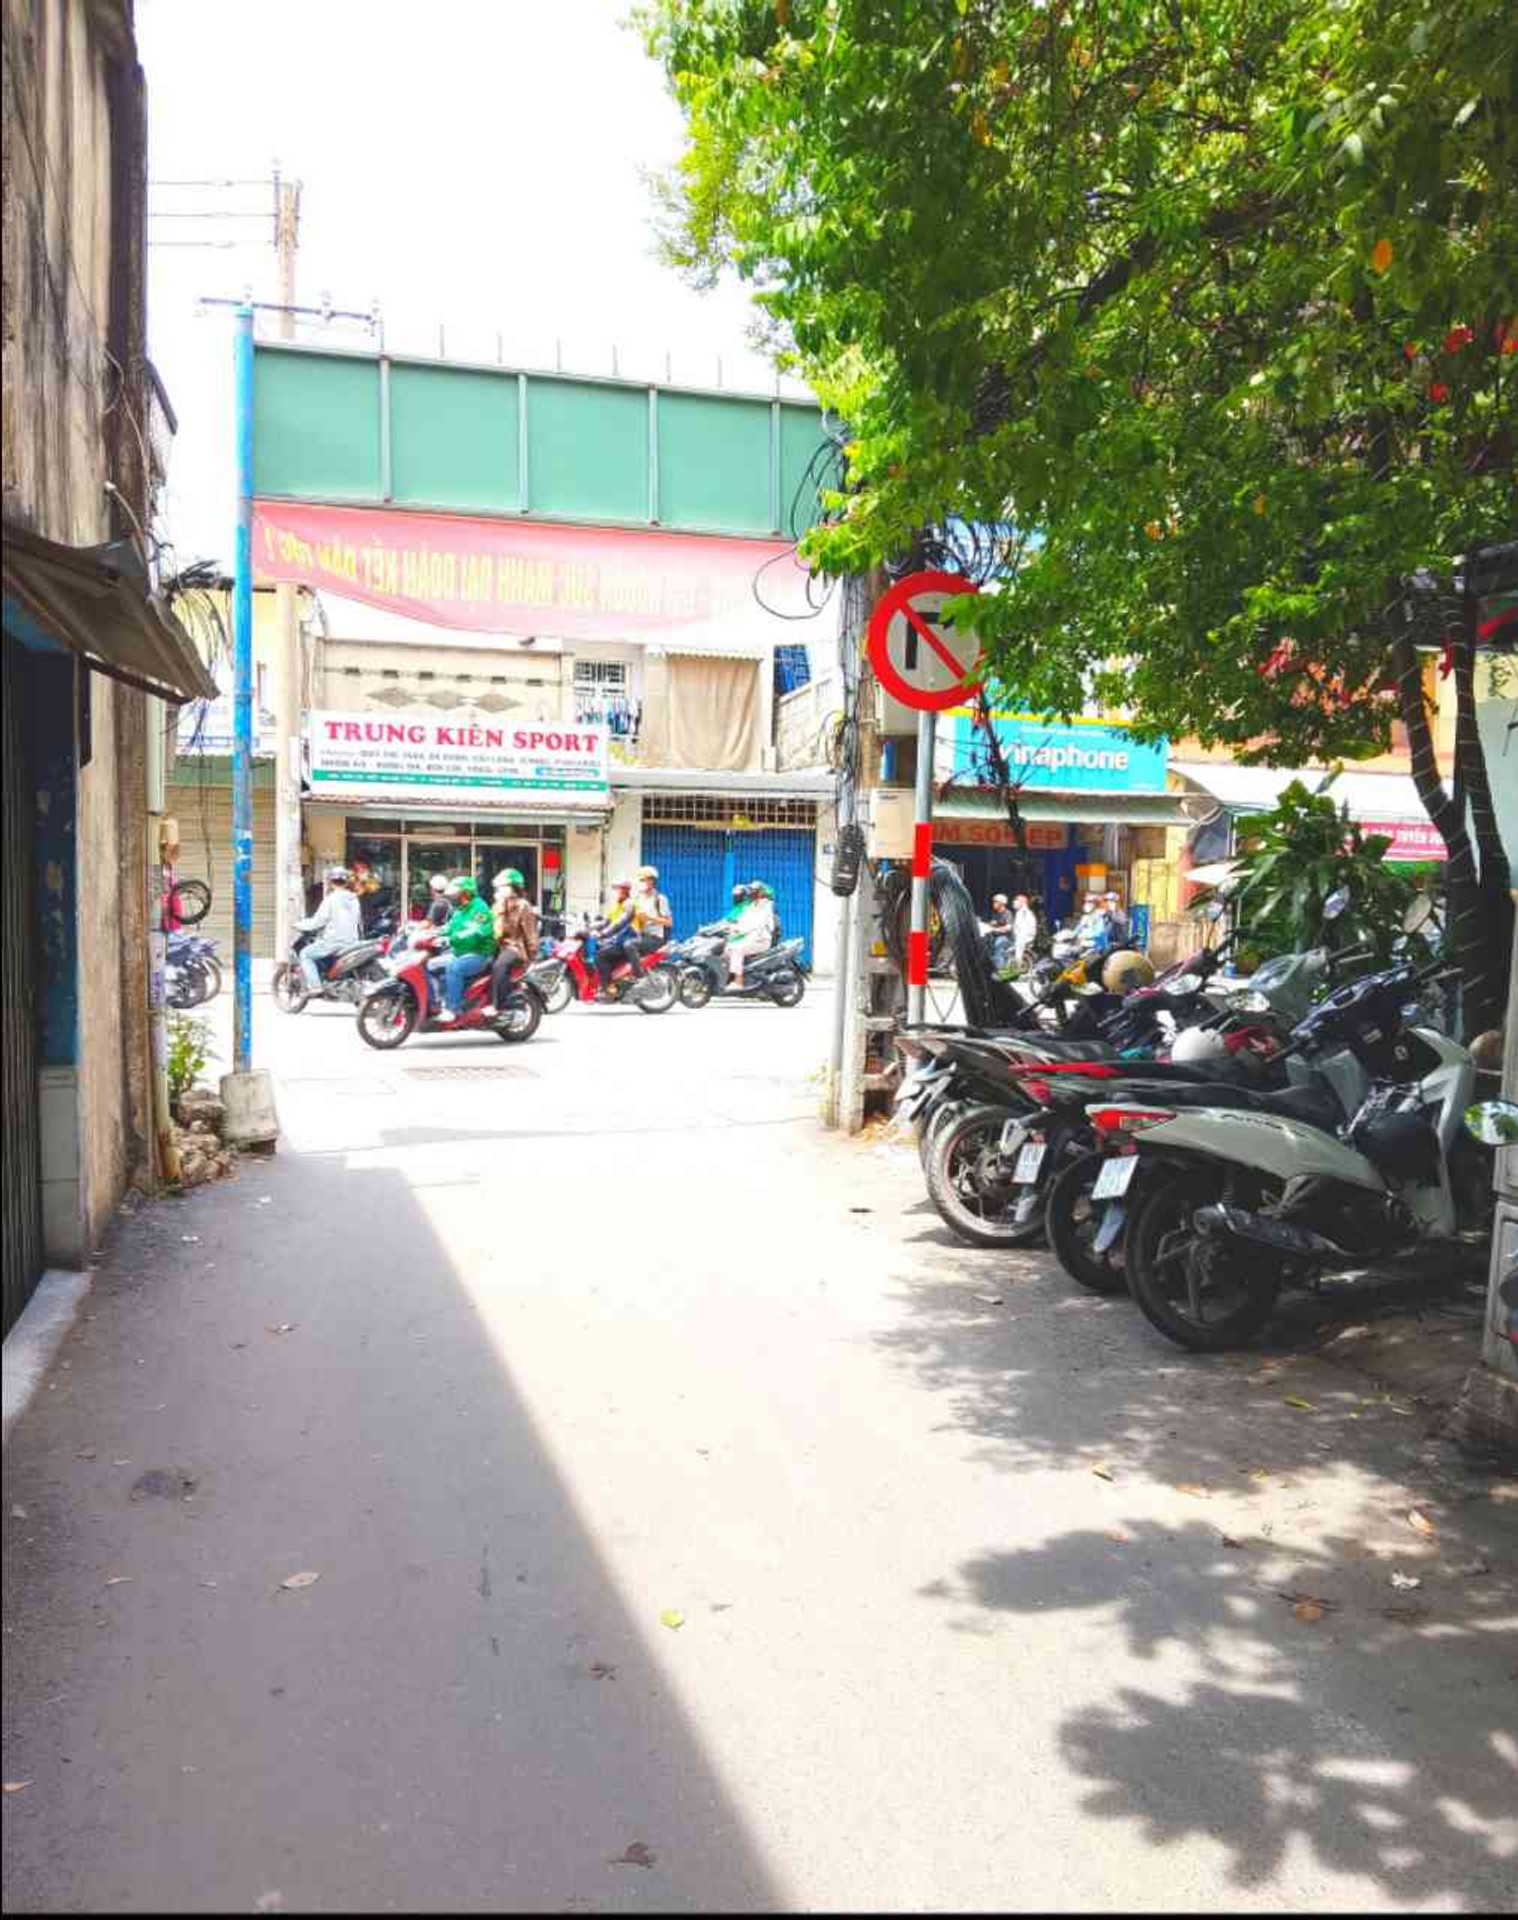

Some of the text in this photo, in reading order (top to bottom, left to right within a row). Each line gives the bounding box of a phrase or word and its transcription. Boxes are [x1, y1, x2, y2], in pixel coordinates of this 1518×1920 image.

[324, 720, 599, 753] TRUNG KIÊN SPORT
[999, 741, 1129, 772] vinaphone
